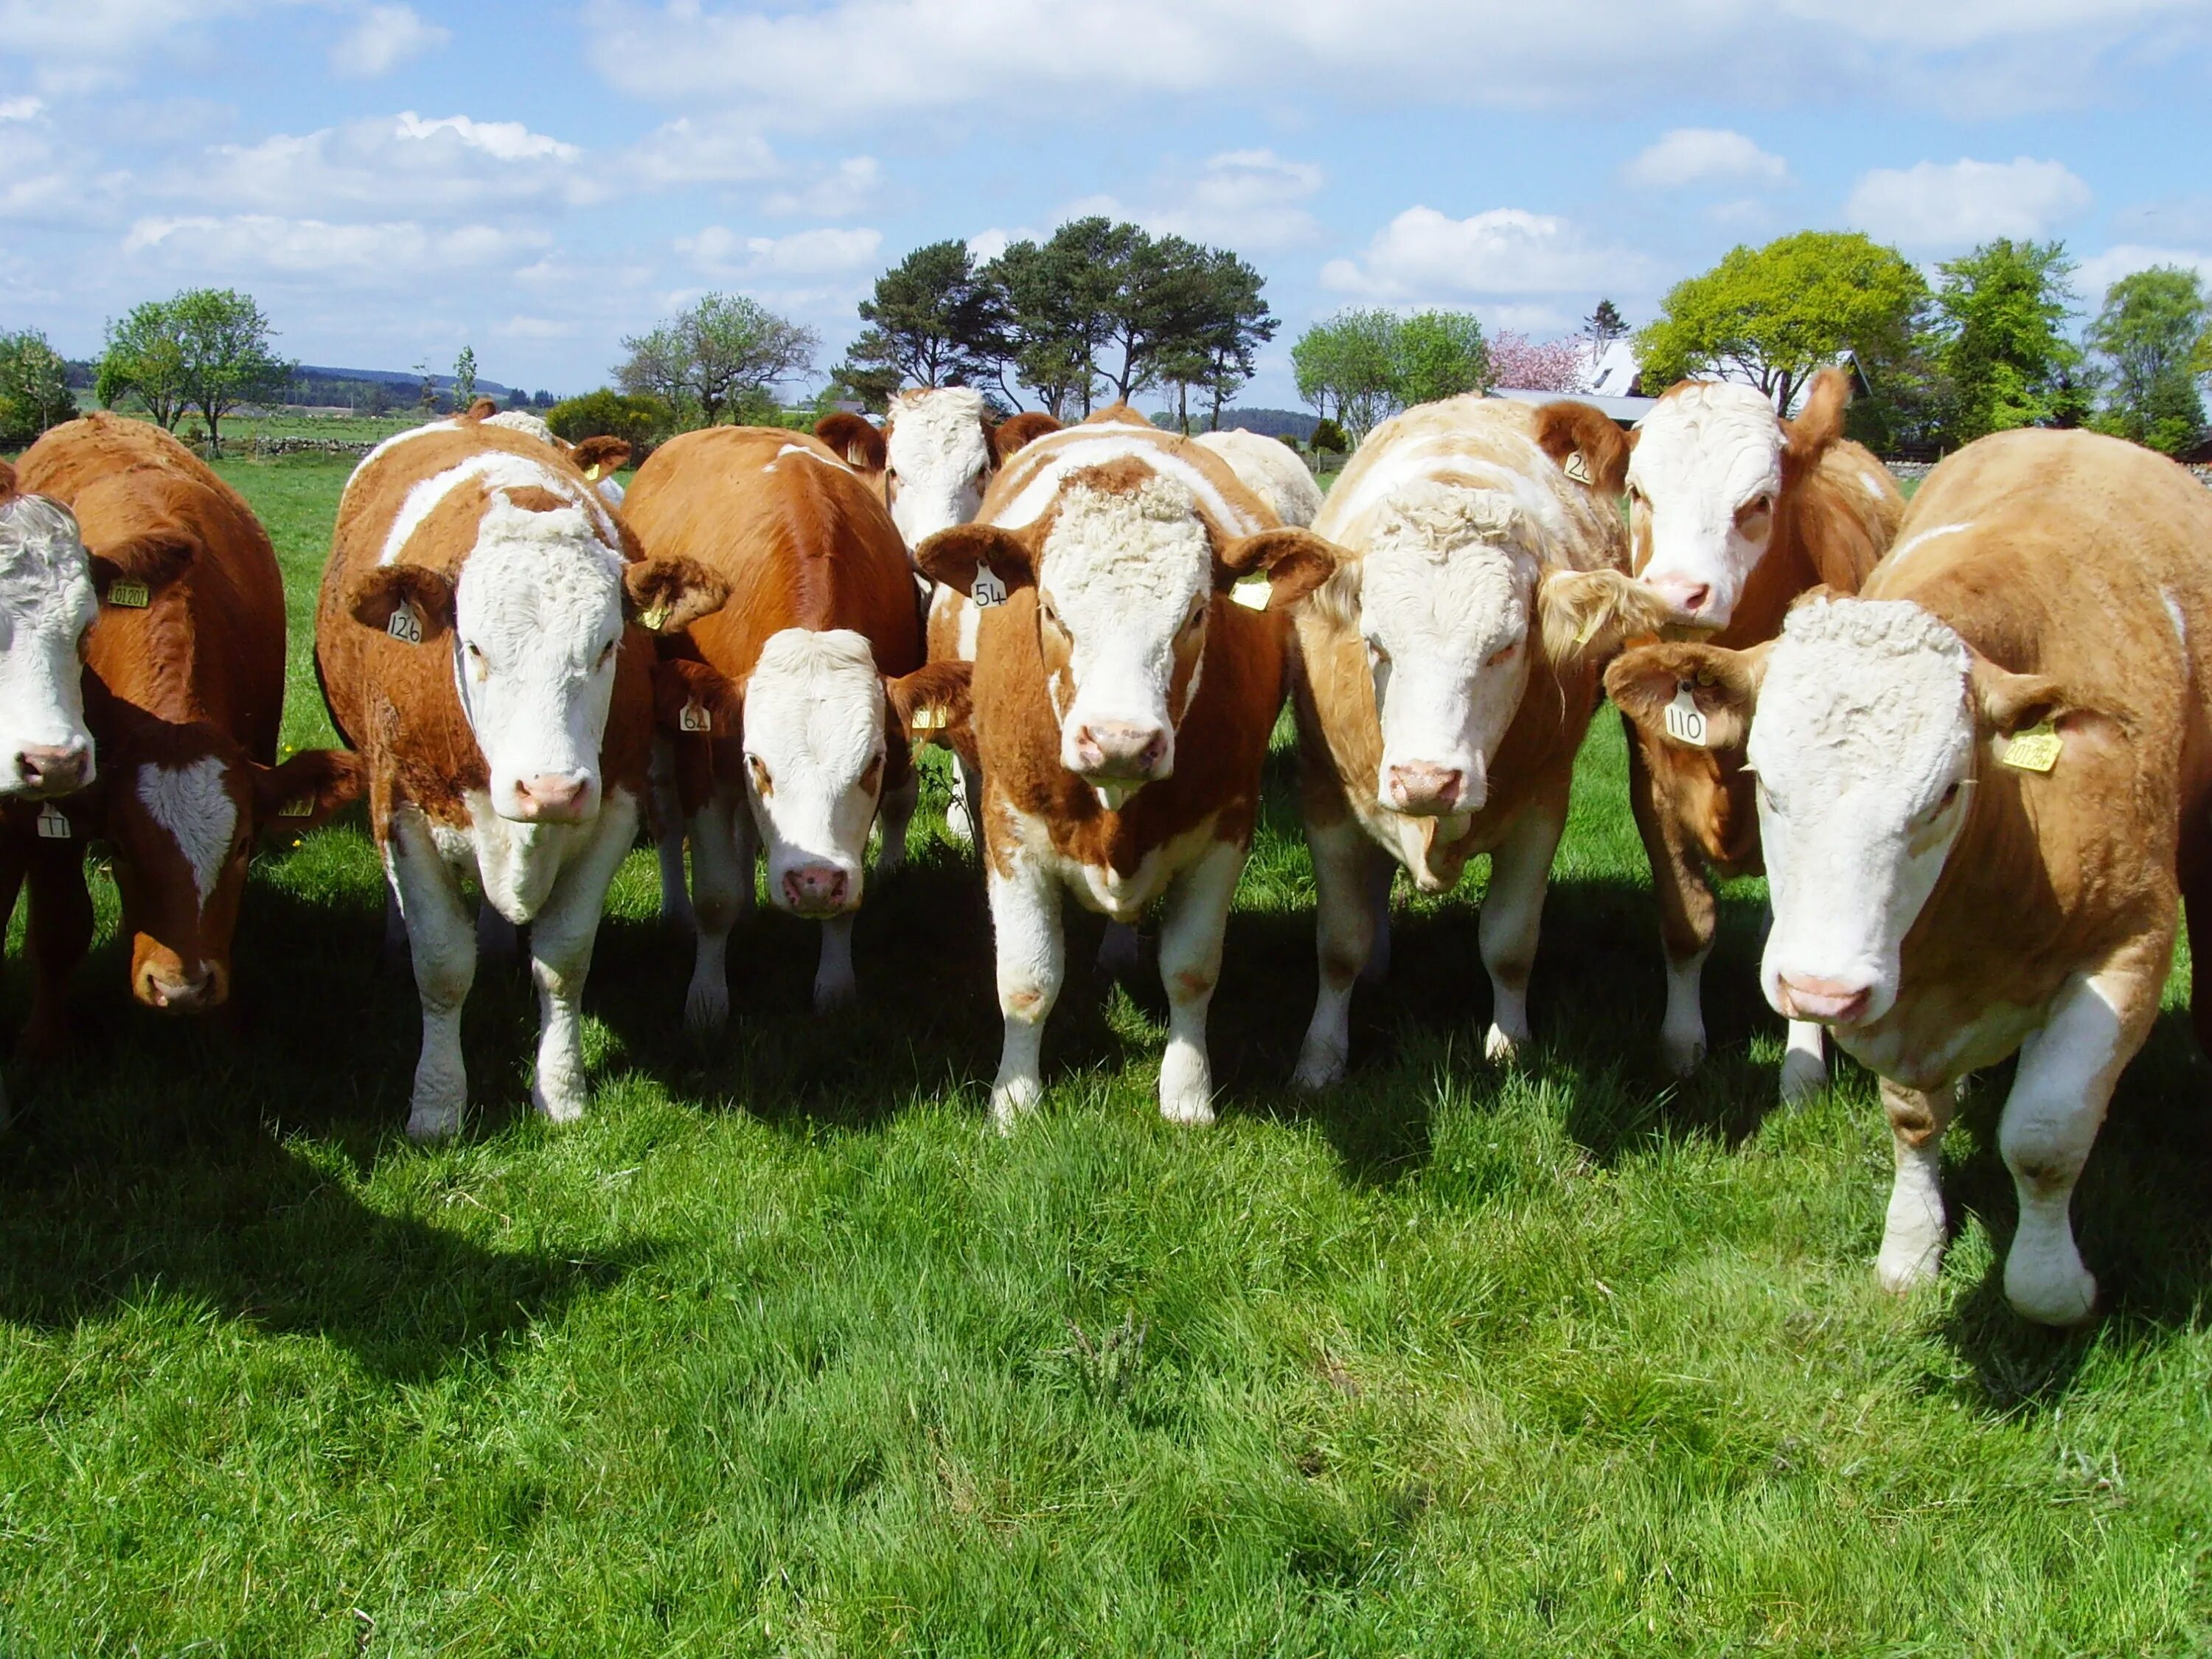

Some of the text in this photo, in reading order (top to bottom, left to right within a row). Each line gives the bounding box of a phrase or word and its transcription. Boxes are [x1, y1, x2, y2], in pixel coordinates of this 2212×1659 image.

[976, 583, 1006, 606] 54
[391, 615, 420, 641] 126
[1670, 709, 1701, 739] 110
[40, 815, 66, 836] 77
